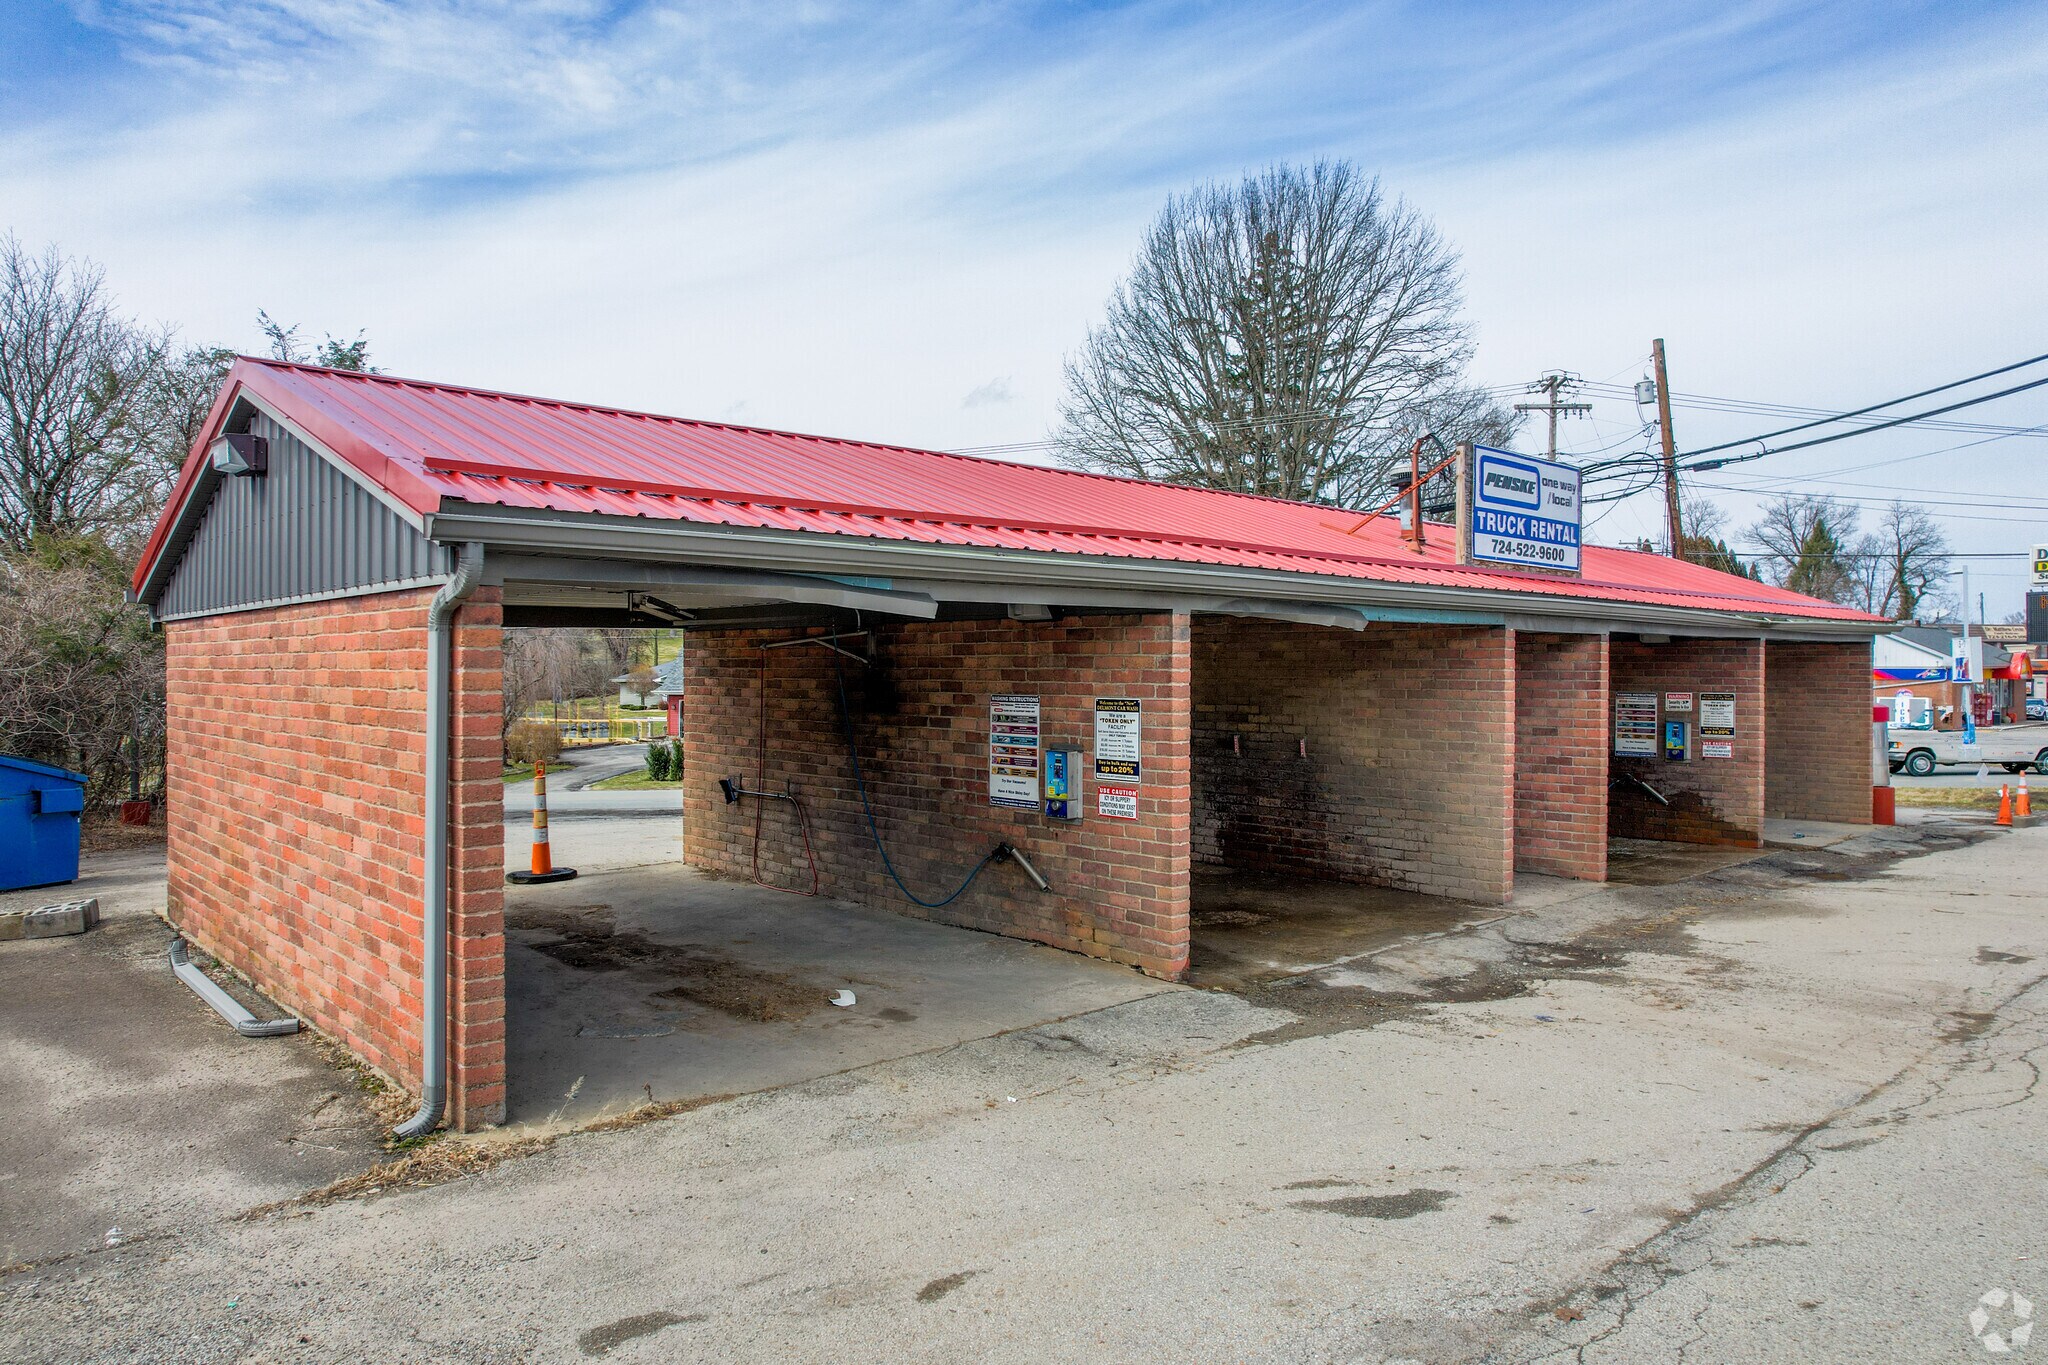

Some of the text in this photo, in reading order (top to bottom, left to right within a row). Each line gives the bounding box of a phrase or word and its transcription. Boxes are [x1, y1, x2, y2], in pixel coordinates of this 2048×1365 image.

[1484, 472, 1536, 494] PENSKE
[1542, 478, 1576, 495] one way
[1477, 510, 1576, 544] TRUCK RENTAL
[1491, 539, 1565, 561] 724-522-9600
